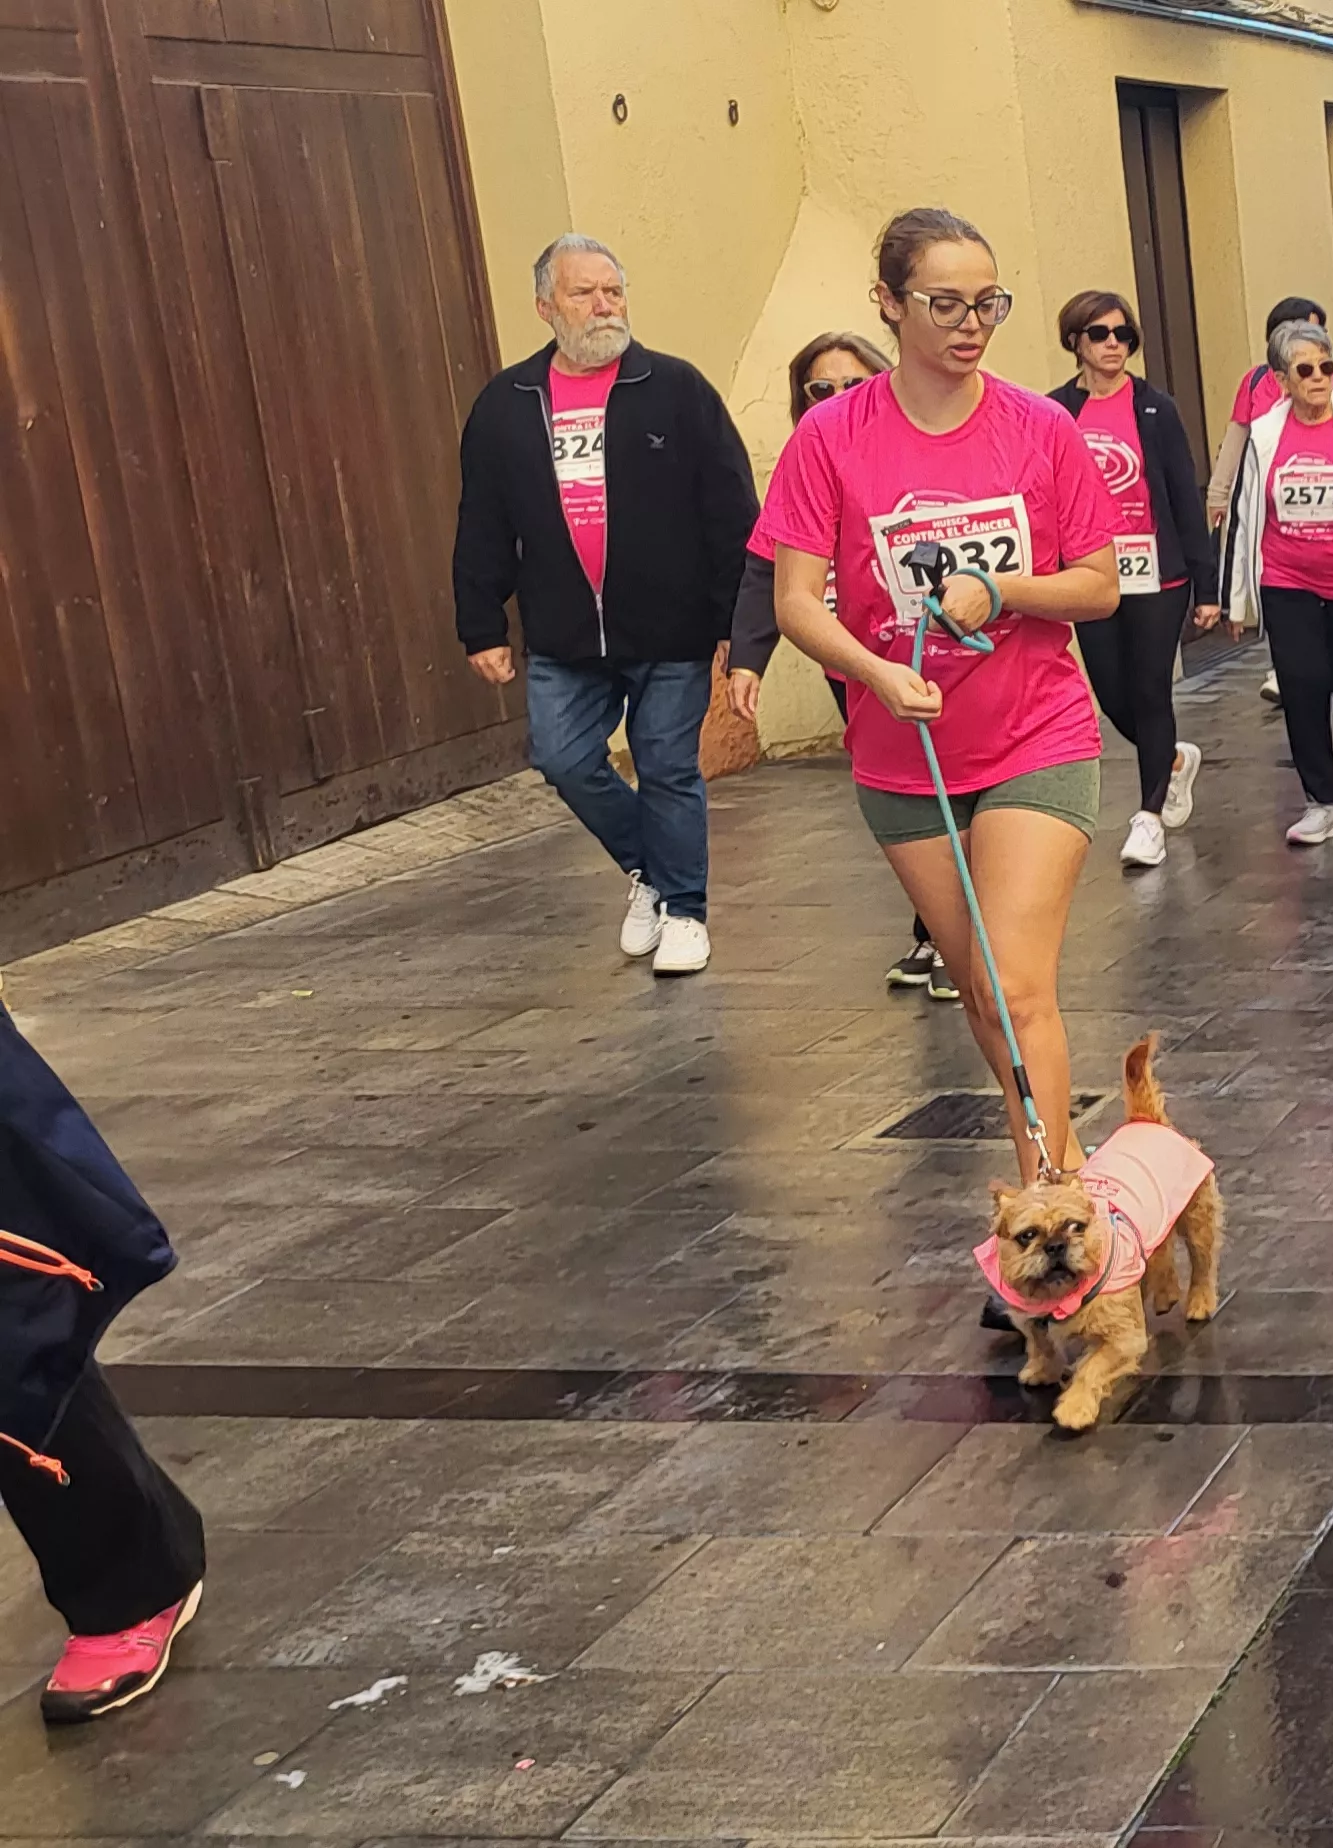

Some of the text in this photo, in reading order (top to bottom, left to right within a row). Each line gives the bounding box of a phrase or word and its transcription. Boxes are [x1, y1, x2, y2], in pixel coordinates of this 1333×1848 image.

[893, 517, 1012, 546] CONTRA EL CÁNCER
[932, 516, 969, 528] HUESCA
[1119, 556, 1151, 577] 82
